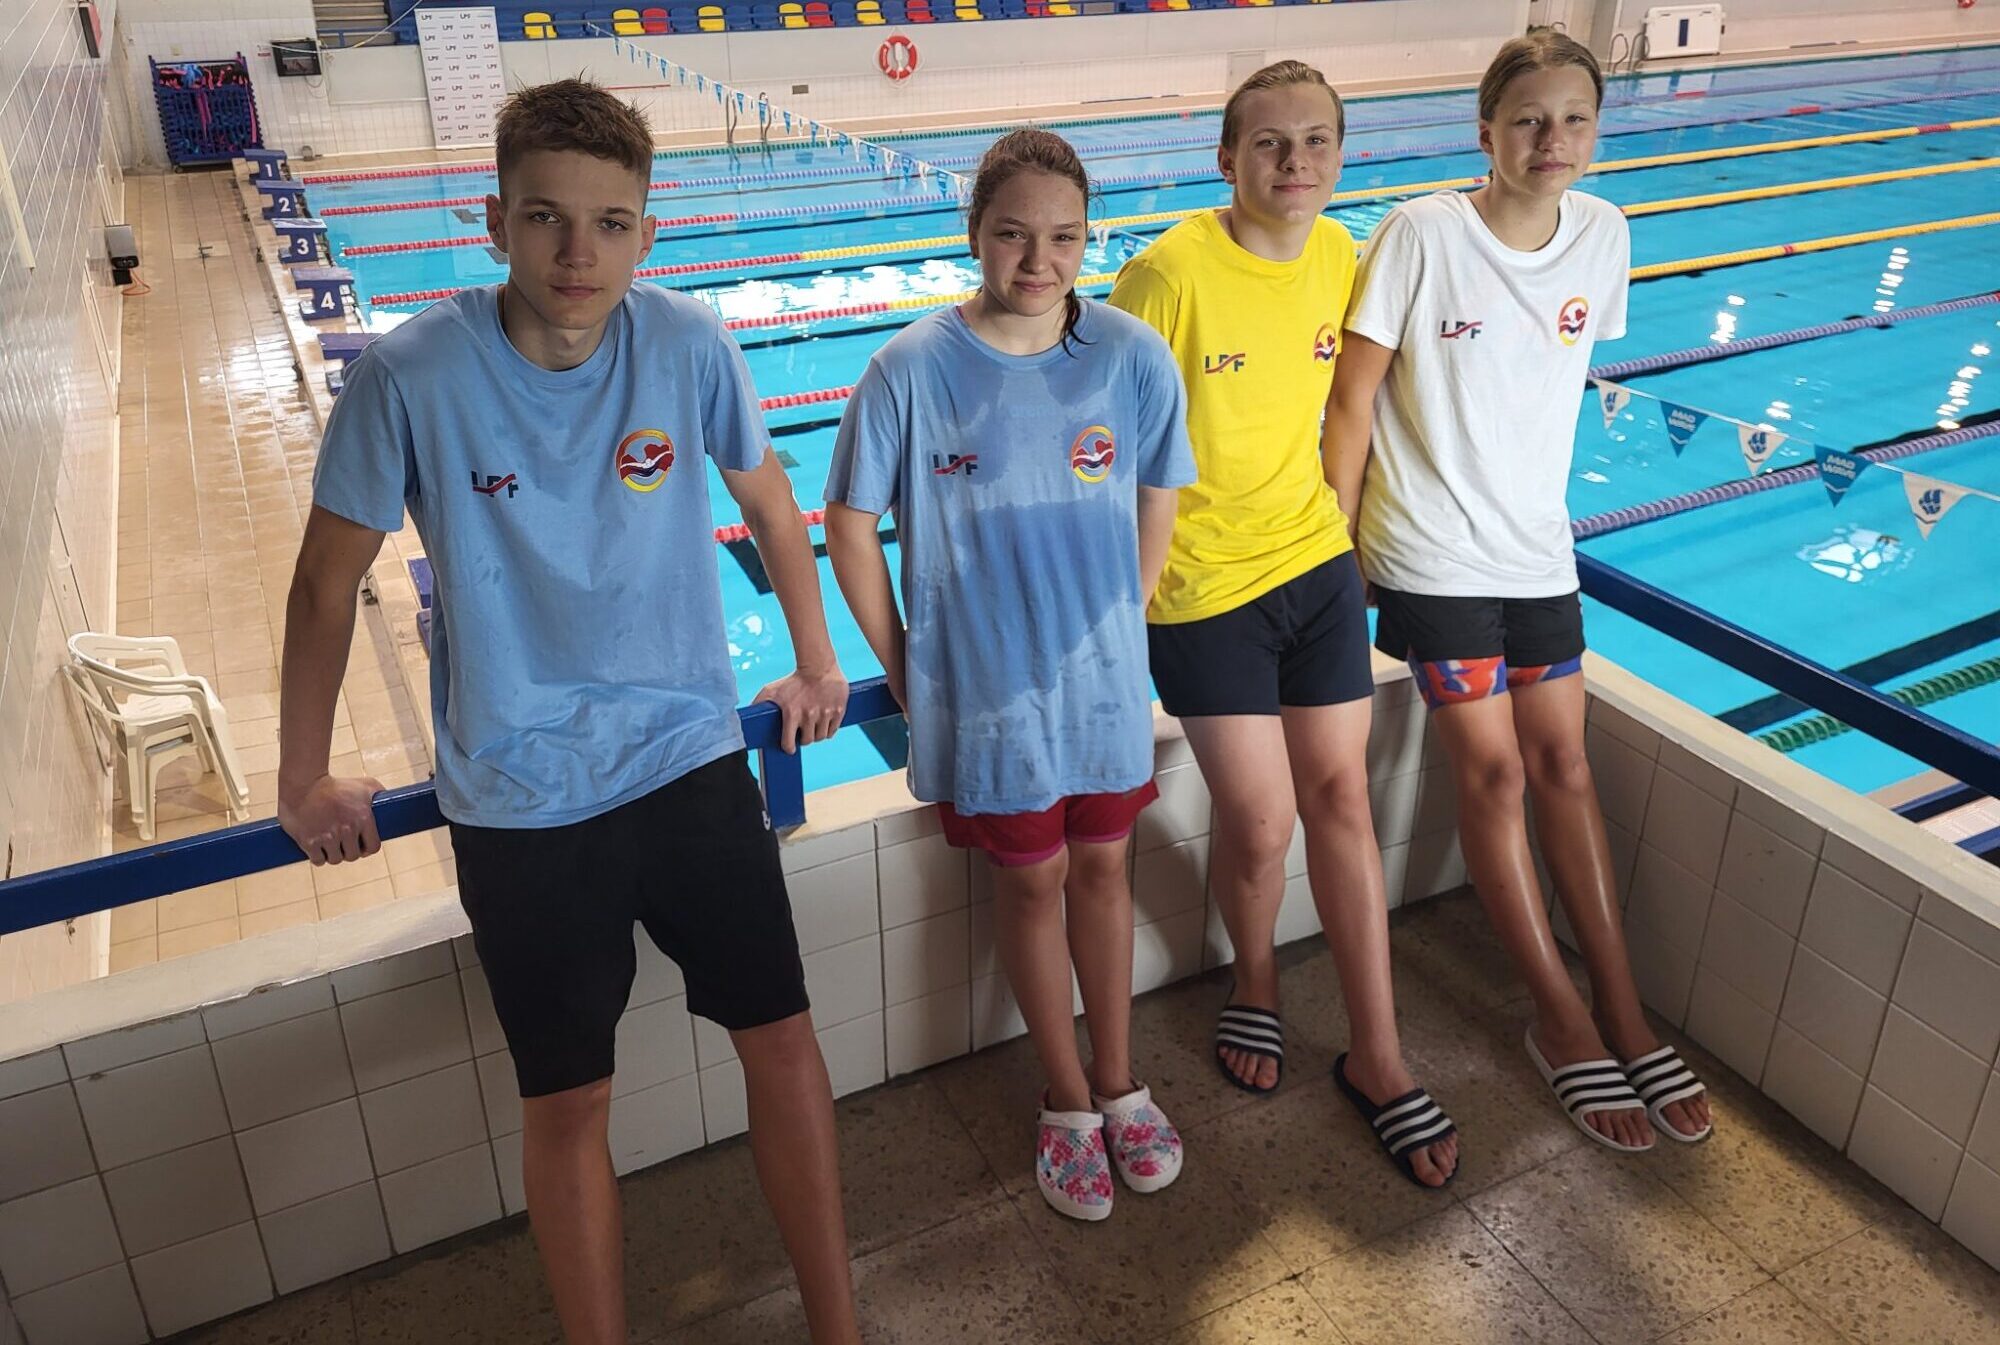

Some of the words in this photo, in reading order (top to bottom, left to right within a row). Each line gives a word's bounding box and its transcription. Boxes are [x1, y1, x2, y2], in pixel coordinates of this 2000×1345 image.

[266, 164, 272, 178] 1
[278, 197, 291, 212] 2
[296, 238, 309, 254] 3
[320, 292, 335, 310] 4
[1440, 320, 1483, 340] LPF
[1205, 352, 1246, 374] LPF
[932, 454, 978, 476] LPF
[471, 470, 519, 499] LPF
